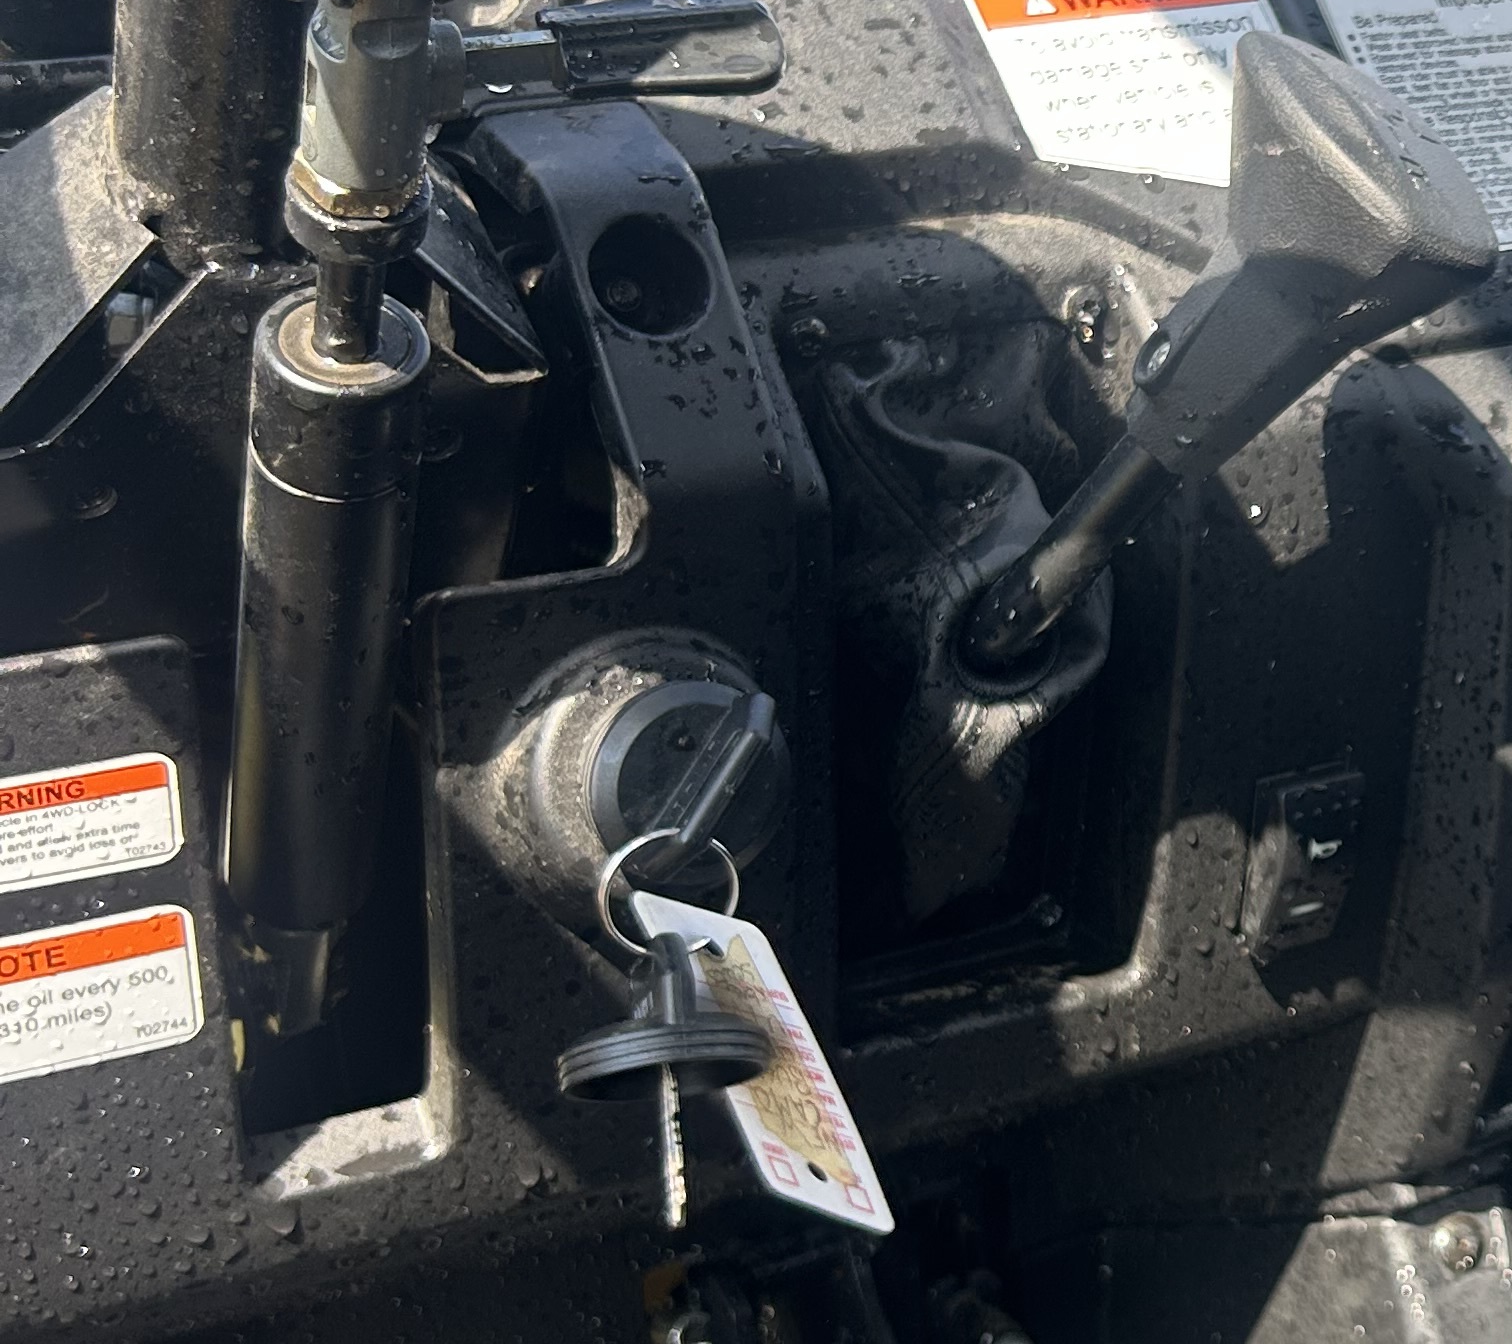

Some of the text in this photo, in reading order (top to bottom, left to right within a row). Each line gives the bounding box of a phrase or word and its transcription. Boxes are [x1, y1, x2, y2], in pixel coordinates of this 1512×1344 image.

[1183, 49, 1228, 68] only
[25, 812, 38, 822] in
[42, 799, 120, 819] 4WD-LOCK
[8, 840, 33, 853] and
[76, 827, 108, 840] extra
[112, 822, 140, 833] time
[125, 842, 166, 856] T02743
[32, 849, 45, 861] to
[49, 843, 85, 857] avoid
[89, 840, 116, 850] loss
[62, 978, 120, 1001] every
[47, 1001, 112, 1027] miles)
